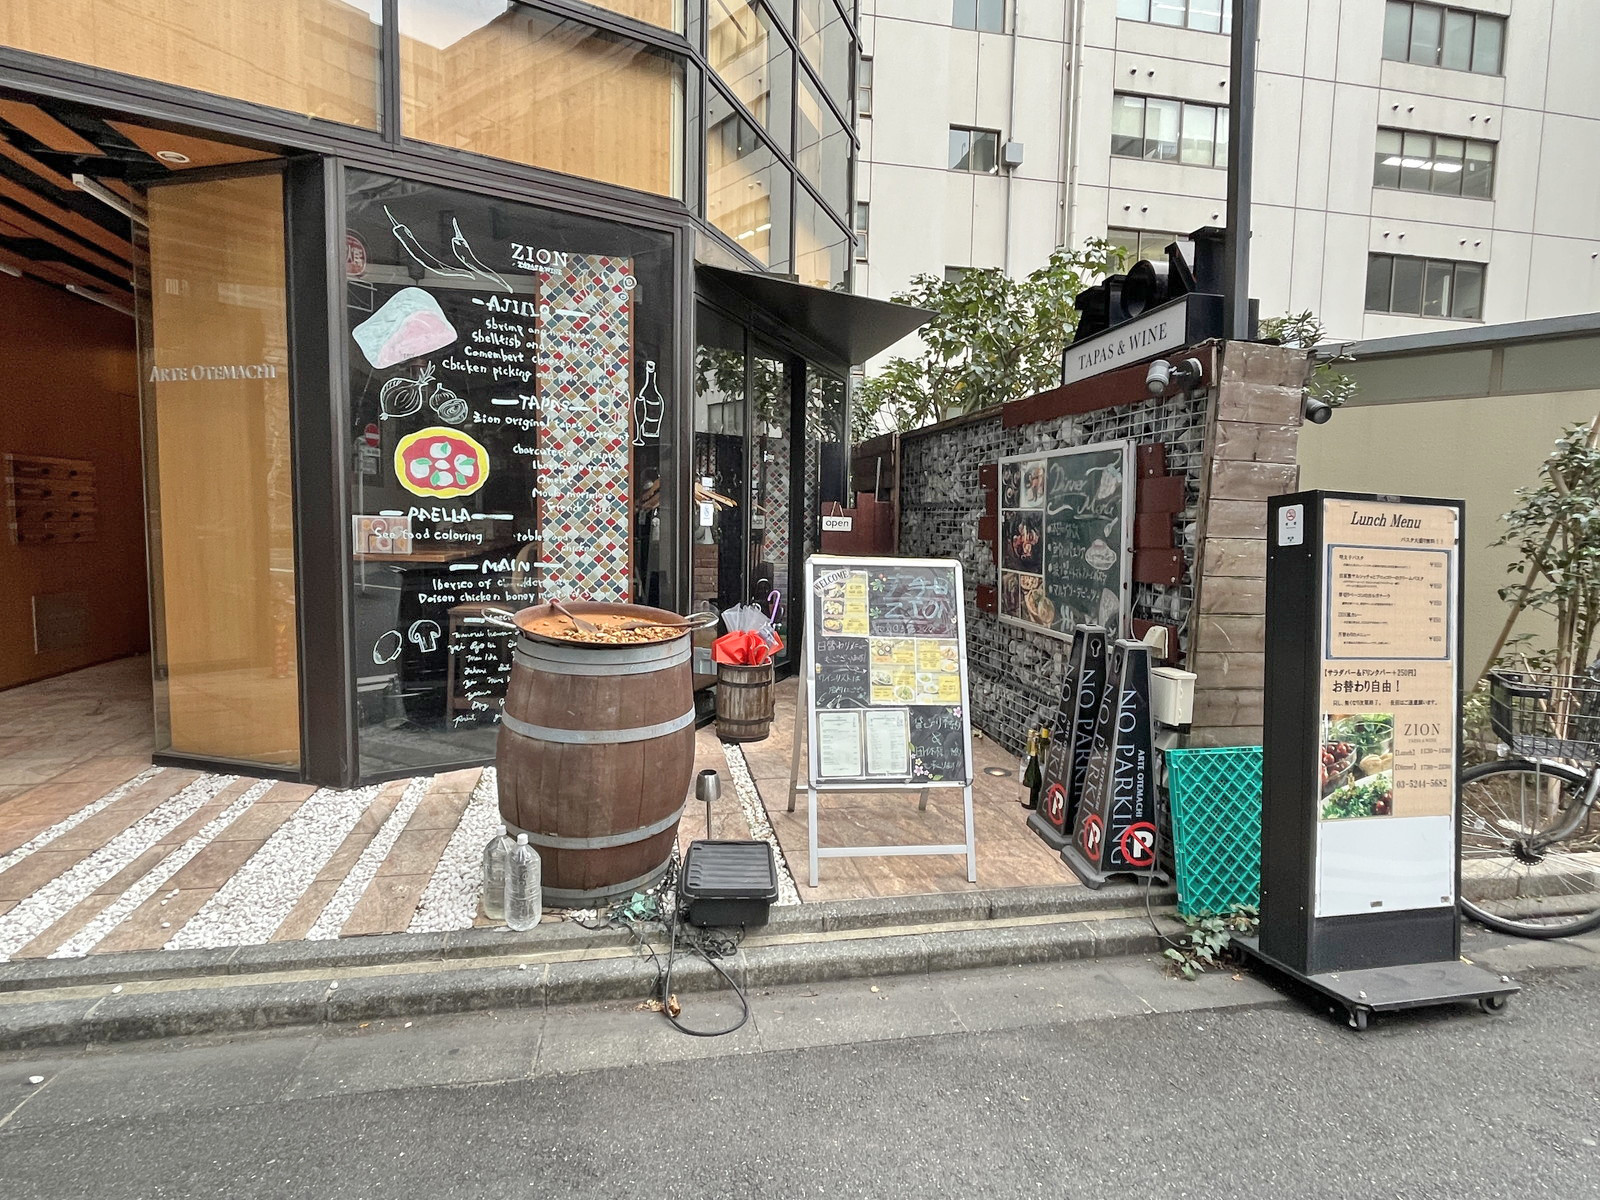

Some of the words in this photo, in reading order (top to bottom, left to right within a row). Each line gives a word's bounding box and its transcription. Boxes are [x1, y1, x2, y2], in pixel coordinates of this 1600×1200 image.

[511, 243, 569, 267] ZION
[486, 295, 550, 317] AJILLO
[464, 346, 524, 363] Camembert
[1078, 344, 1114, 371] TAPAS
[1117, 340, 1125, 356] &
[1129, 322, 1168, 350] WINE
[150, 366, 188, 382] ARTE
[191, 364, 276, 380] OTEMACHI
[519, 395, 570, 411] TAPAS
[408, 506, 472, 523] PAELLA
[826, 519, 849, 529] open
[1351, 512, 1387, 527] Lunch
[1390, 513, 1422, 529] Menu
[402, 527, 430, 540] food
[434, 529, 483, 543] coloring
[482, 558, 531, 574] MAIN
[433, 578, 473, 591] Iberico
[478, 577, 492, 589] of
[814, 570, 849, 590] WELCOME
[1061, 664, 1075, 702] NO
[1080, 669, 1096, 709] NO
[1332, 680, 1400, 693] お替わり自由！
[1099, 683, 1115, 725] NO
[1117, 689, 1137, 734] NO
[1404, 723, 1440, 736] ZION
[1137, 749, 1146, 771] ARTE
[1111, 744, 1135, 864] PARKING
[1135, 772, 1145, 818] OTEMACHI
